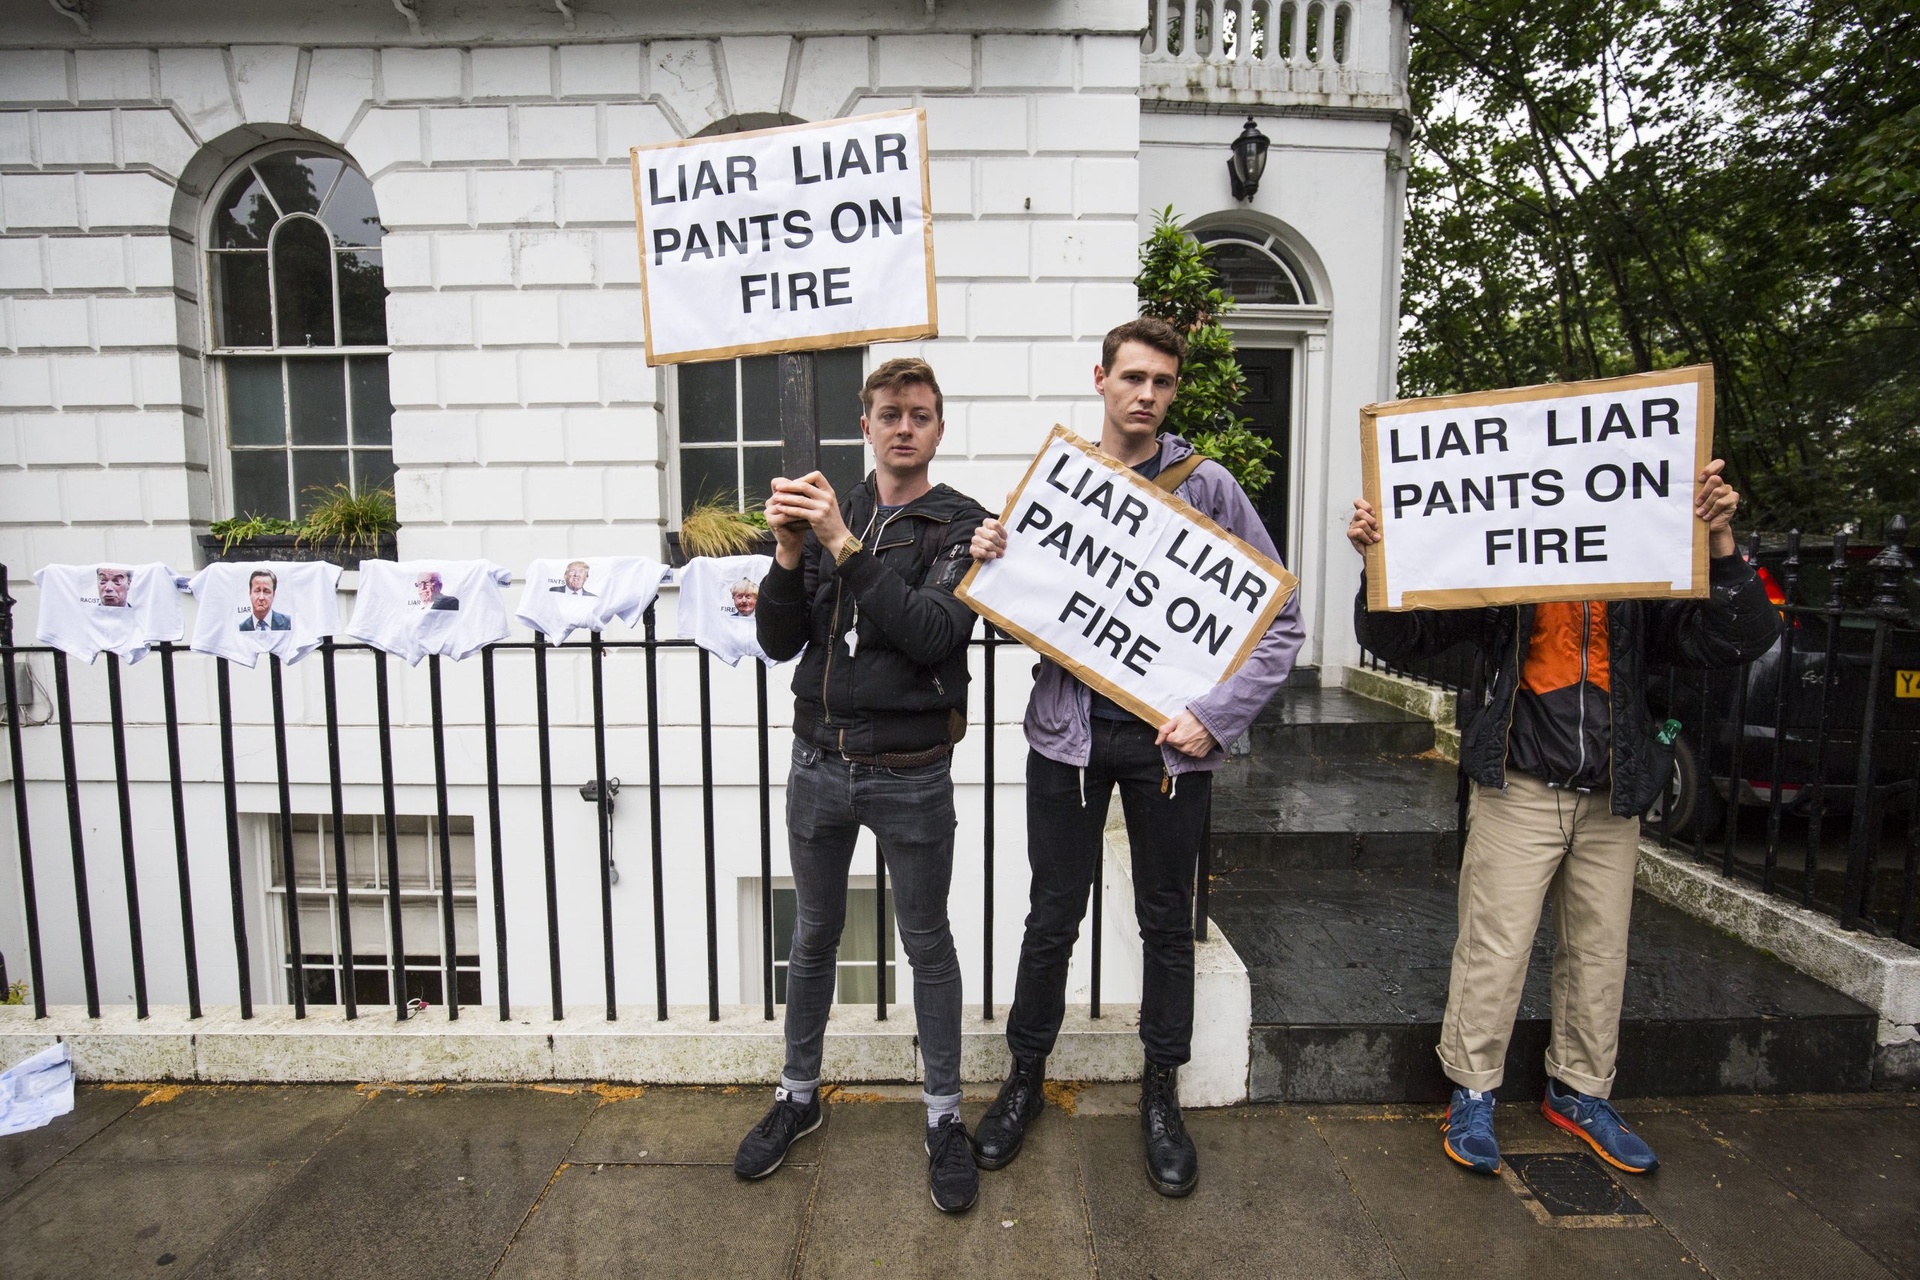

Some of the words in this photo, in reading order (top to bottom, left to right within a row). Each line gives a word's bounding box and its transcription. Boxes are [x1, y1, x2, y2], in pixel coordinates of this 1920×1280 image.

[648, 156, 758, 206] LIAR
[792, 132, 908, 185] LIAR
[653, 209, 814, 266] PANTS
[830, 196, 903, 244] ON
[740, 266, 853, 314] FIRE
[1390, 416, 1509, 464] LIAR
[1547, 397, 1680, 447] LIAR
[1393, 469, 1565, 519] PANTS
[1584, 459, 1669, 503] ON
[1046, 453, 1149, 538] LIAR
[1165, 528, 1267, 614] LIAR
[1485, 525, 1608, 566] FIRE
[237, 606, 252, 614] LIAR
[1015, 501, 1161, 608] PANTS
[1165, 596, 1233, 656] ON
[1058, 590, 1162, 677] FIRE
